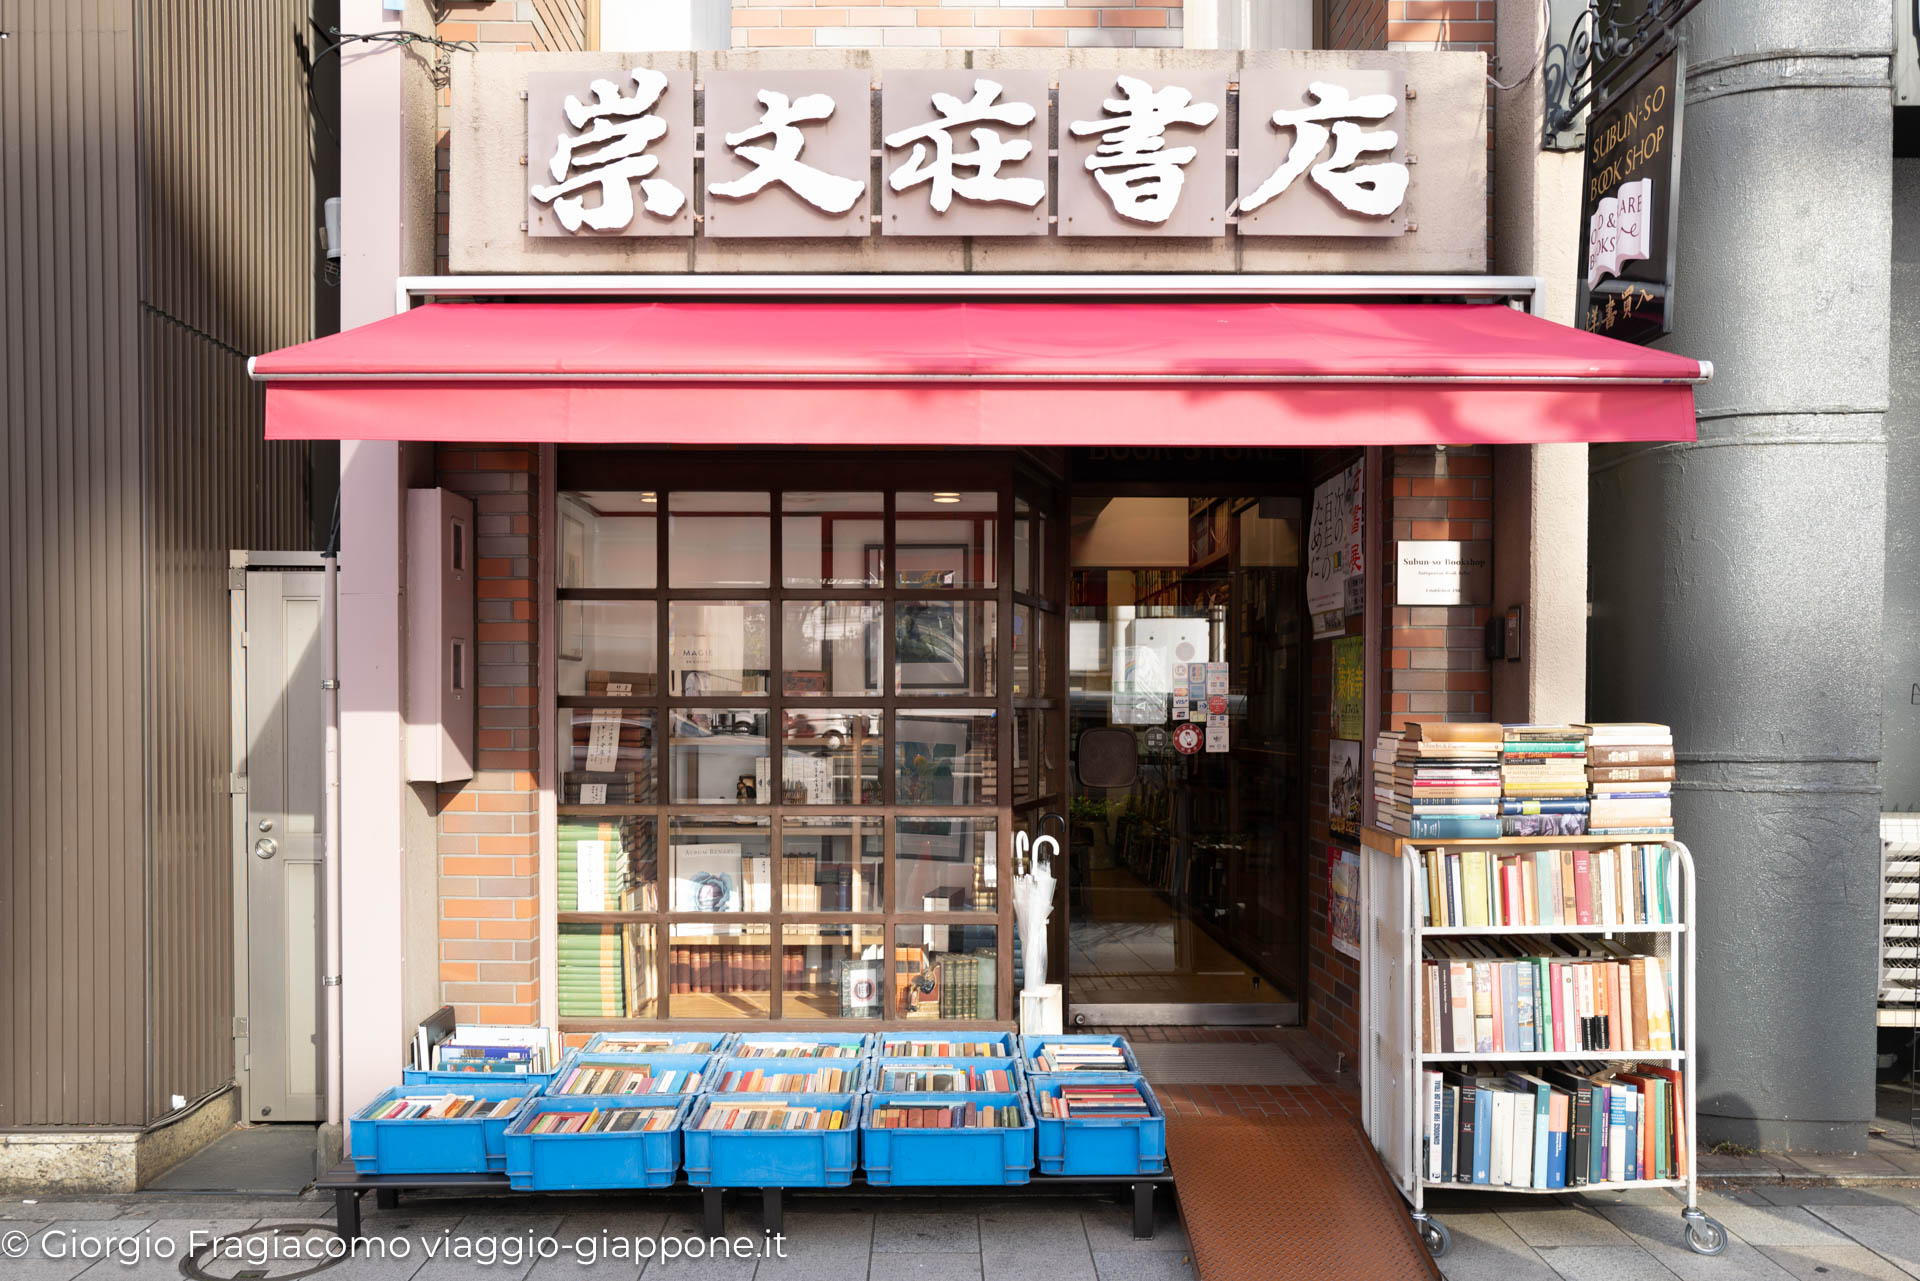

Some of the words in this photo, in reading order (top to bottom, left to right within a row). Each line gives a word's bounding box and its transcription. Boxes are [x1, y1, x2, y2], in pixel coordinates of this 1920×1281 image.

[531, 67, 1410, 231] 崇文荘書店
[1592, 85, 1666, 164] SUBUN-SO
[1590, 156, 1623, 202] BOOK
[1625, 125, 1665, 175] SHOP
[1590, 214, 1604, 245] OD
[1606, 212, 1617, 229] &
[1617, 194, 1642, 217] ARE
[1403, 557, 1441, 566] Subun-so
[1445, 557, 1486, 568] Bookshop
